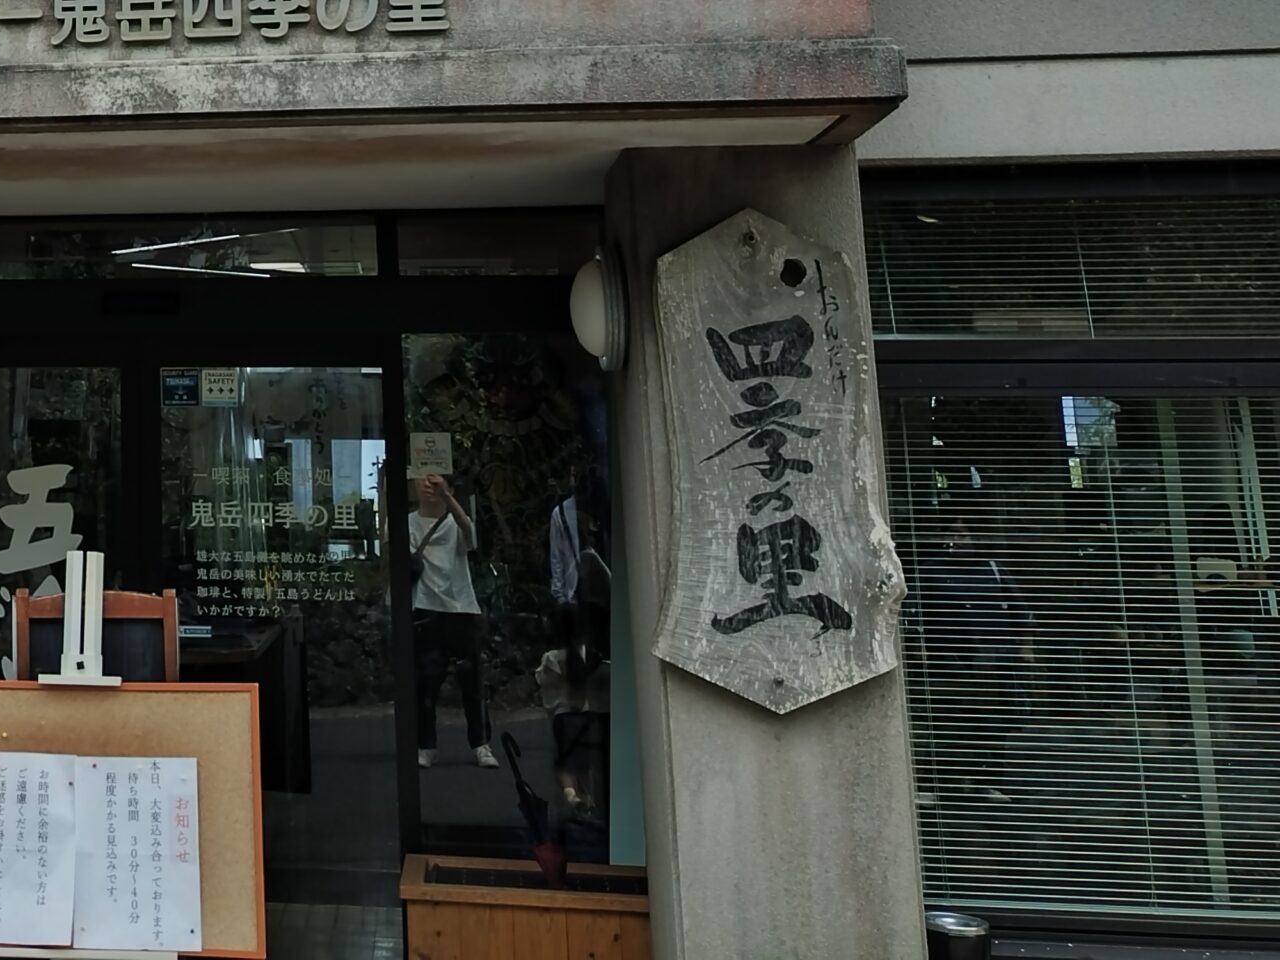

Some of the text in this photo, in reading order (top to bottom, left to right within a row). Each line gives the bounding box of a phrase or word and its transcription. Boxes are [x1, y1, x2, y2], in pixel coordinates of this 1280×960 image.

[189, 499, 359, 530] 鬼岳四季の里
[698, 314, 853, 638] 四季の里
[196, 549, 331, 563] 雄大な五島灘を眺めなが
[197, 604, 282, 619] いかがですか？
[15, 767, 28, 860] ご遠慮ください。
[36, 768, 50, 906] お時間に余裕のない方は
[127, 772, 140, 823] 待ち時間
[175, 796, 191, 864] お知らせ
[105, 772, 119, 905] 程度かかる見込みです。
[149, 759, 165, 948] 本日、大変込み合っております。
